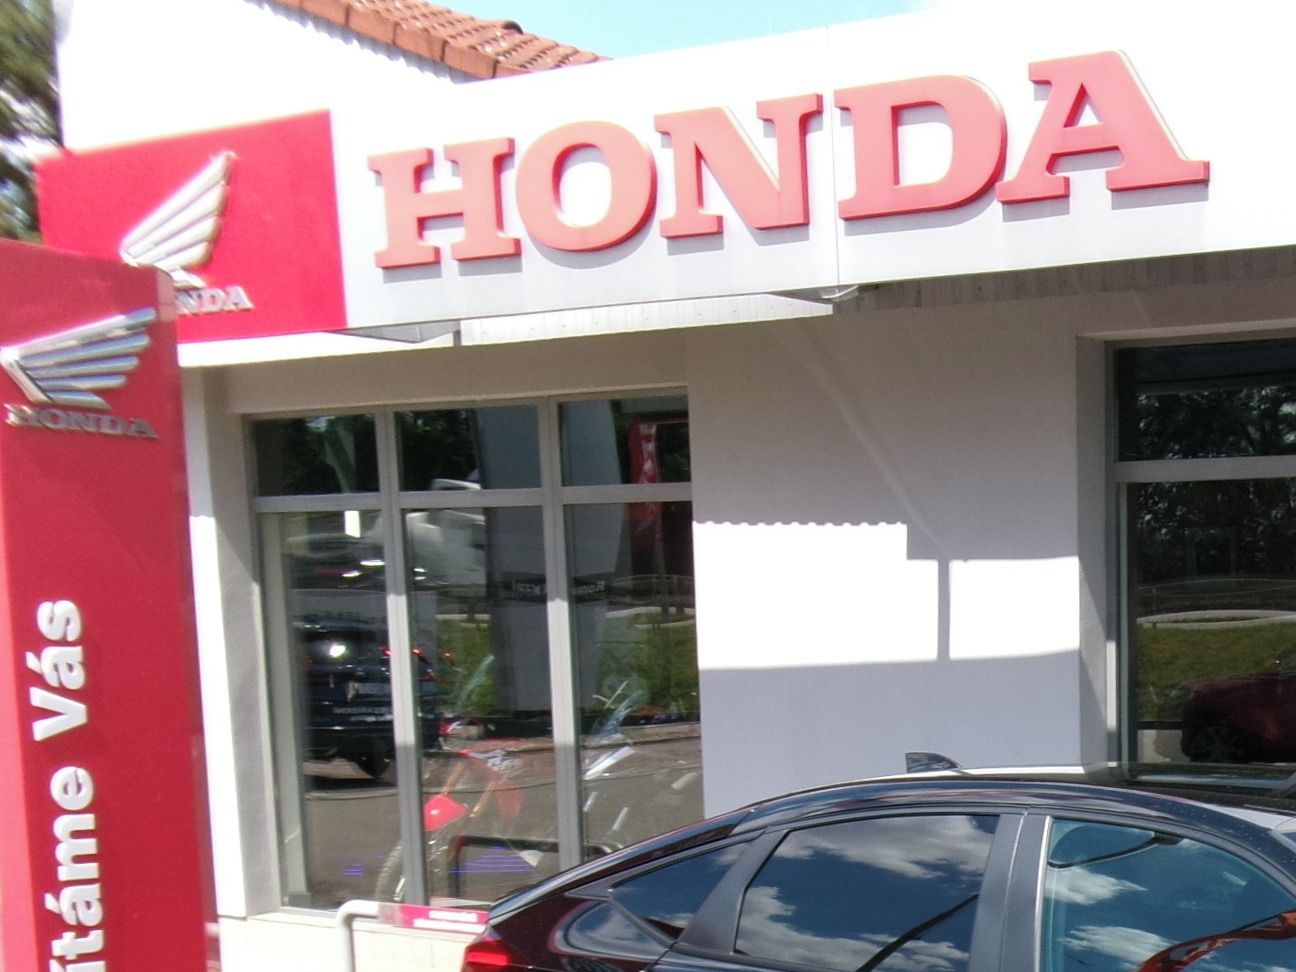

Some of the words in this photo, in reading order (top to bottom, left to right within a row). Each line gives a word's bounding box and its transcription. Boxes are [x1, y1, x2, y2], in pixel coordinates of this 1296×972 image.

[367, 50, 1209, 268] HONDA
[175, 285, 254, 316] NDA
[4, 403, 159, 439] HONDA
[26, 599, 88, 741] Vás
